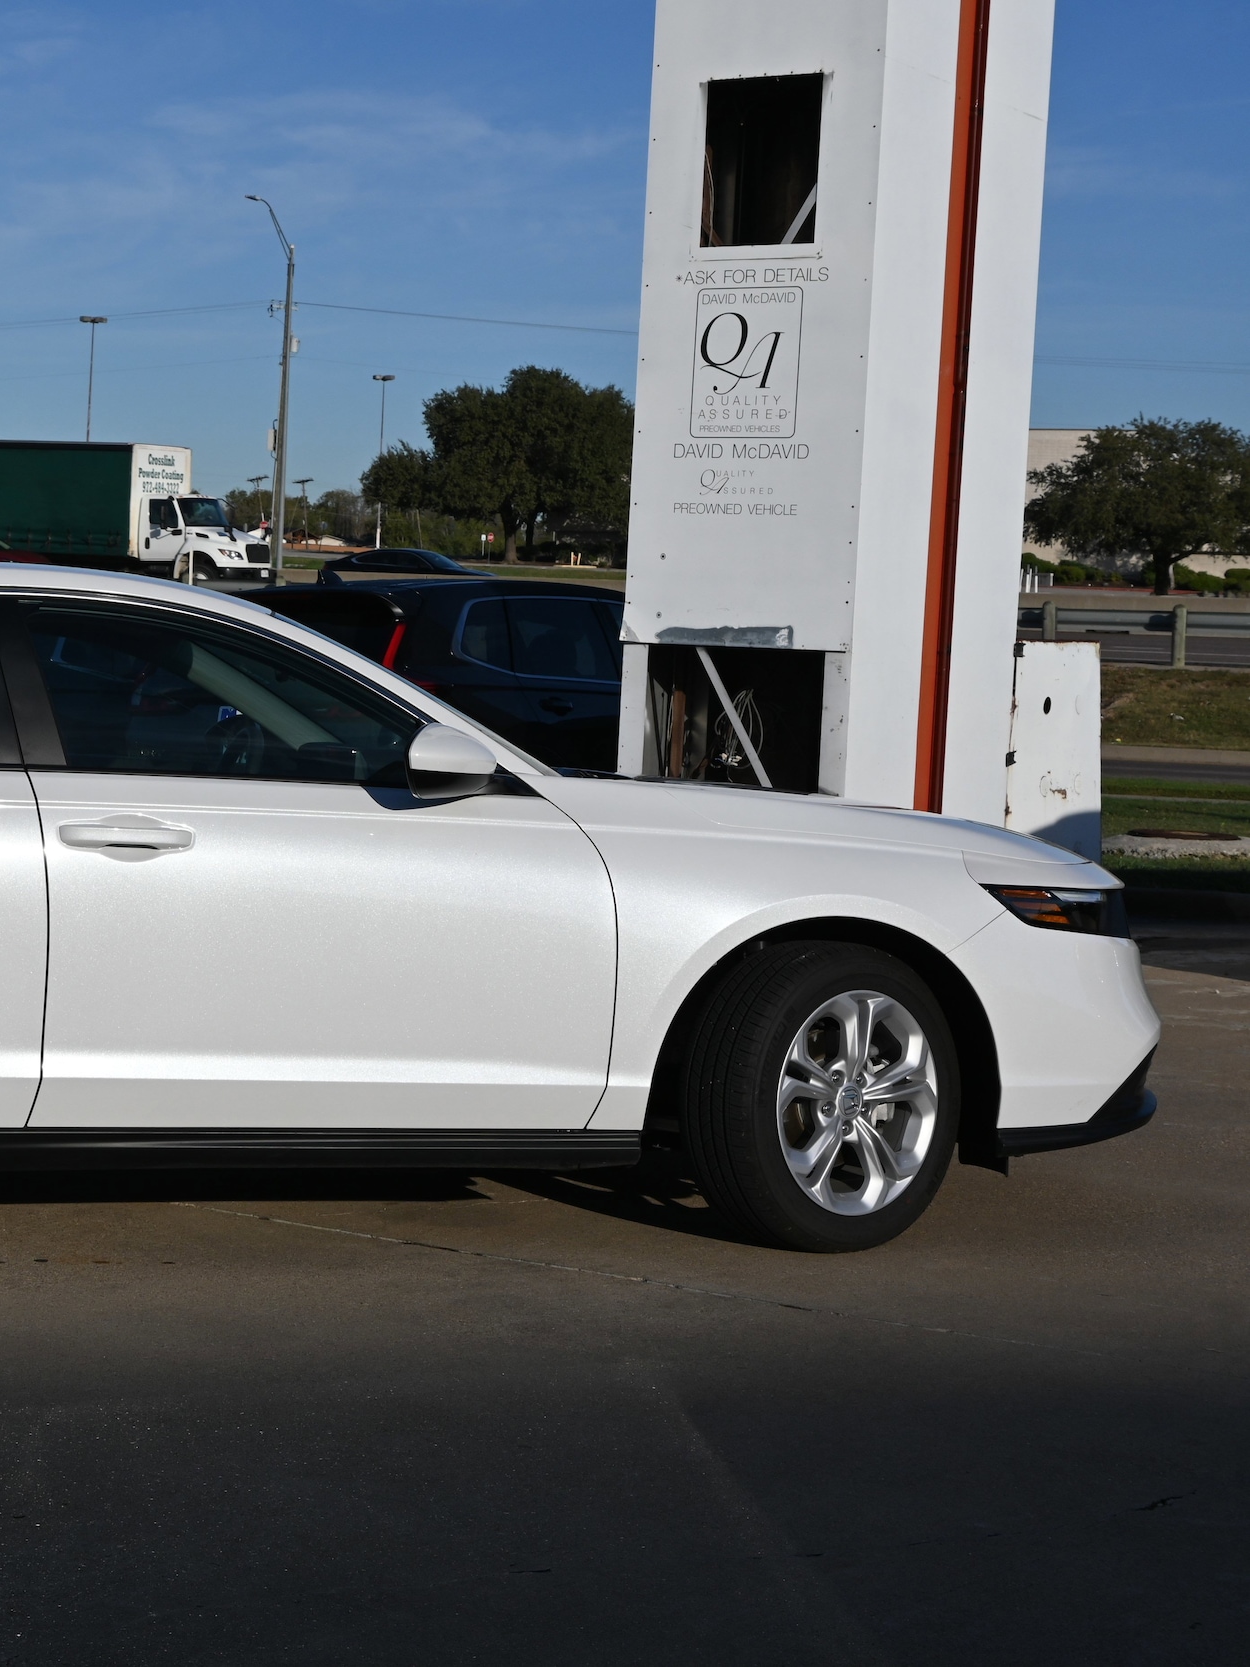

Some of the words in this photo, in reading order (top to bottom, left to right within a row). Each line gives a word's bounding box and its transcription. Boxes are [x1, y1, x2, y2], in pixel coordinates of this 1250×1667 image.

[723, 269, 757, 284] FOR
[764, 266, 830, 283] DETAILS
[701, 293, 737, 305] DAVID
[742, 291, 797, 305] McDAVID
[705, 395, 781, 406] QUALITY
[698, 409, 788, 419] ASSURED
[699, 425, 742, 433] PREOWNED
[745, 425, 781, 433] VEHICLES
[673, 443, 724, 459] DAVID
[732, 443, 810, 460] McDAVID
[148, 453, 175, 467] Crosslink
[138, 467, 160, 479] Powder
[161, 469, 184, 484] Coating
[673, 502, 742, 515] PREOWNED
[747, 503, 798, 516] VEHICLE
